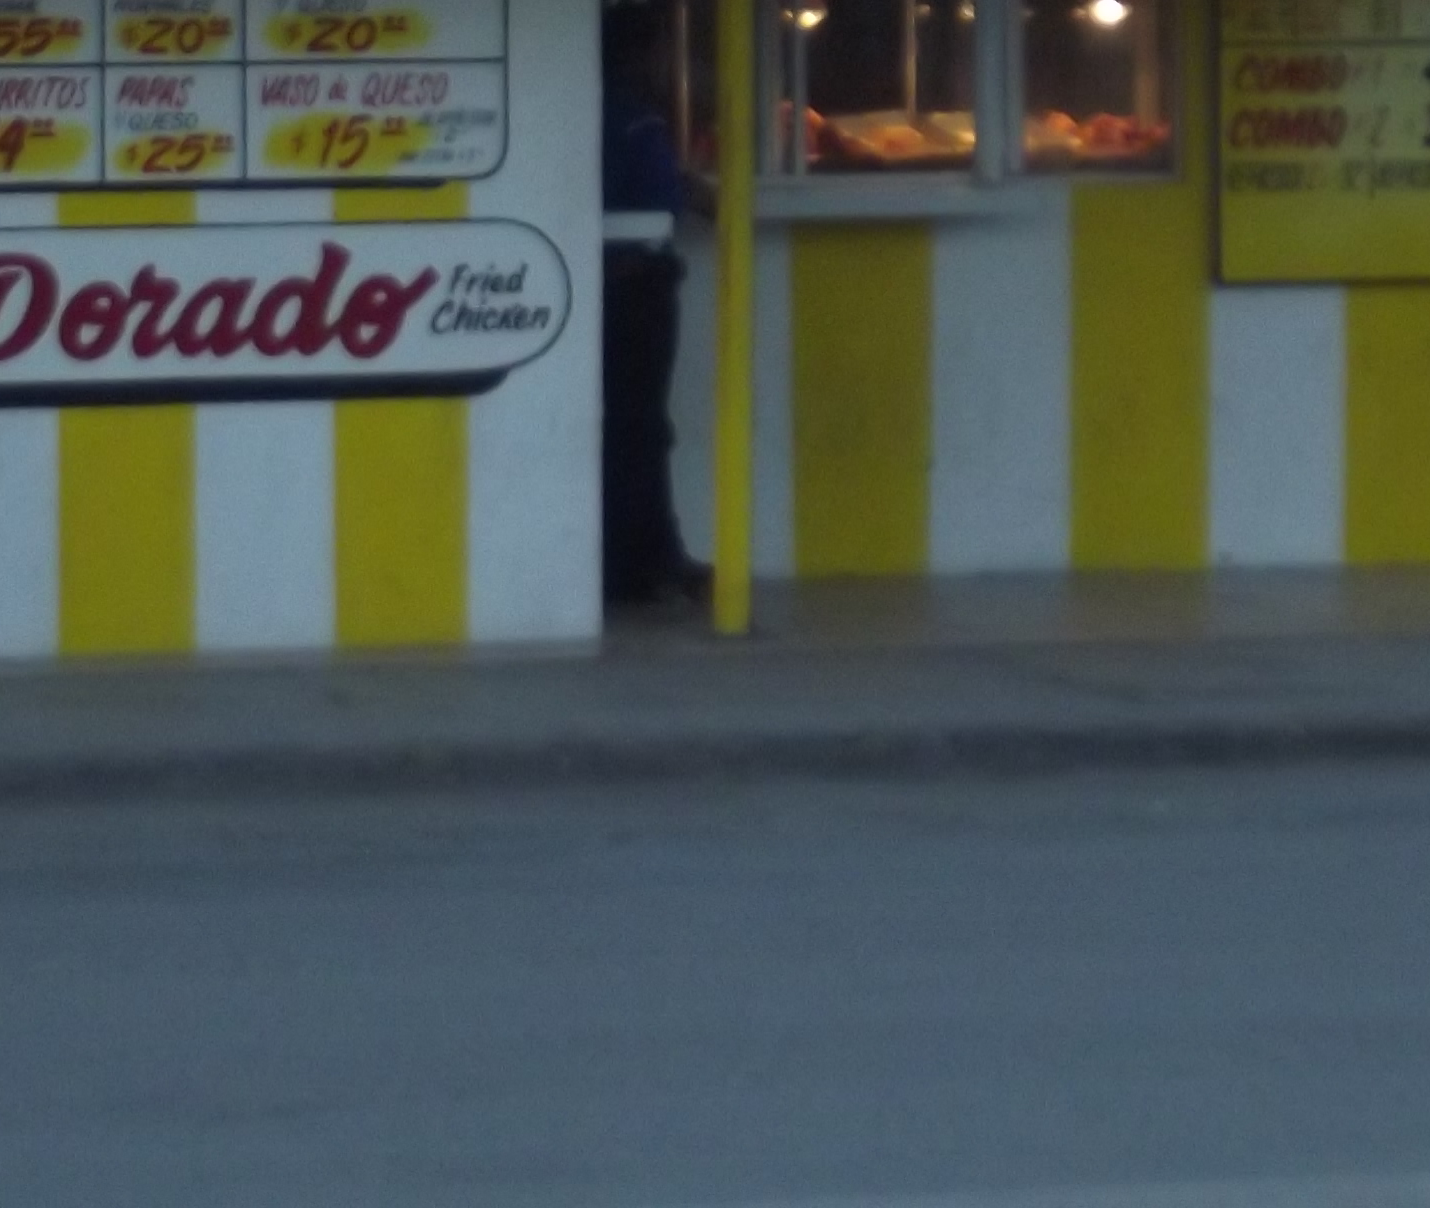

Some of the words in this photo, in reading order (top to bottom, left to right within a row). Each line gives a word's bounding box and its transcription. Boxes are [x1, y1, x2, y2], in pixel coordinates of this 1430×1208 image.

[116, 75, 196, 109] PAPAS
[259, 74, 321, 107] VASO
[359, 71, 451, 106] QUESO
[447, 264, 528, 297] Fried
[429, 300, 551, 335] Chicken
